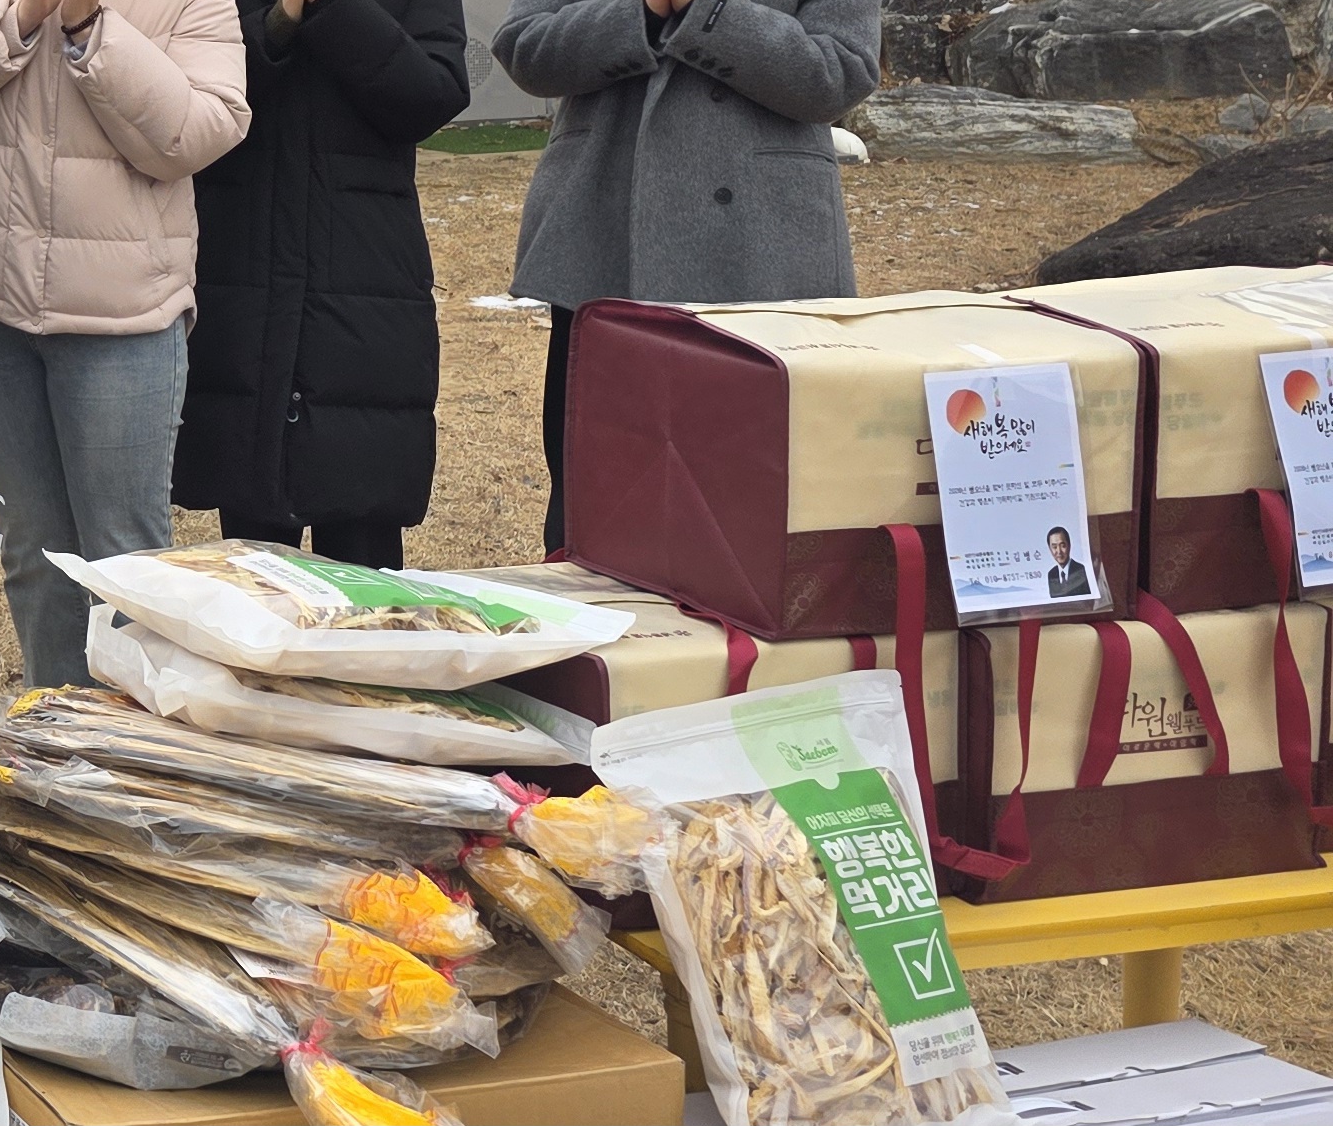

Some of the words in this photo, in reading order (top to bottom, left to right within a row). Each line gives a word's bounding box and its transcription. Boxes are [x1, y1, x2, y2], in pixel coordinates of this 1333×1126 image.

[1301, 399, 1328, 420] 새해
[963, 420, 993, 440] 새해
[994, 413, 1008, 438] 복
[1010, 418, 1035, 436] 많이
[980, 439, 1027, 459] 받으세요
[806, 811, 841, 831] 어차피
[839, 806, 868, 824] 당신의
[821, 828, 922, 879] 행복한
[841, 868, 936, 918] 먹거리
